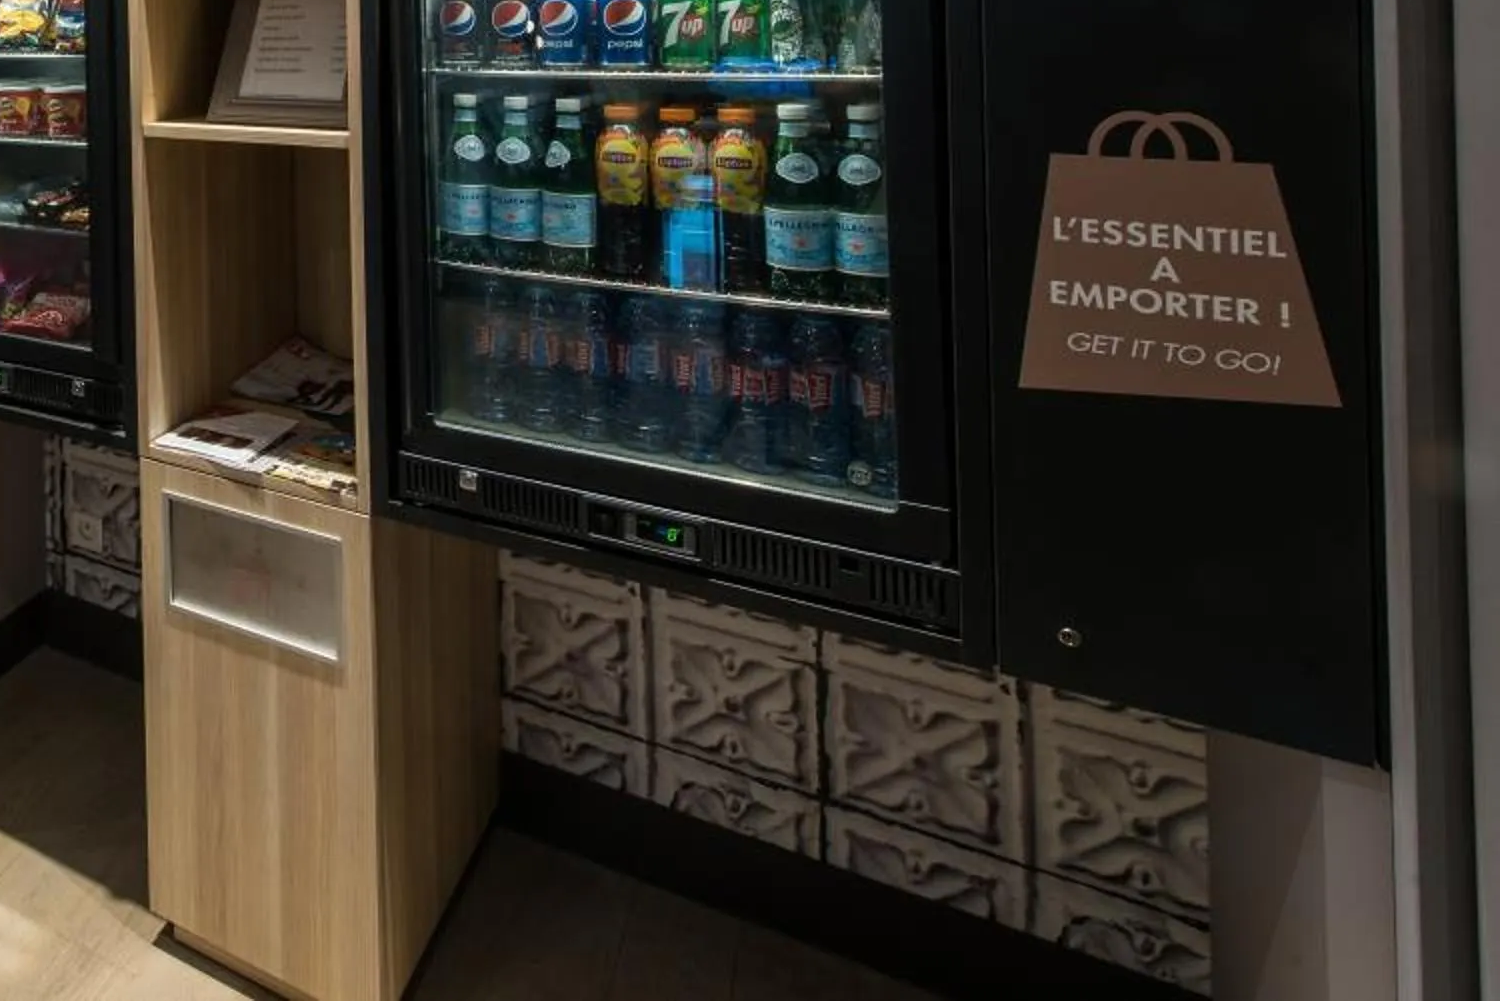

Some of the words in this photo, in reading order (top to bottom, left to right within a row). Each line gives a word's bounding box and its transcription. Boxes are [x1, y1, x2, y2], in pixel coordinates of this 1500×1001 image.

[607, 38, 644, 50] pepsi
[1052, 215, 1288, 259] L'ESSENTIEL
[1149, 255, 1181, 284] A
[1049, 279, 1261, 326] EMPORTER
[1279, 301, 1291, 328] !
[1066, 331, 1125, 357] GET
[1131, 337, 1156, 360] IT
[1163, 341, 1206, 366] TO
[1214, 349, 1282, 377] GO!
